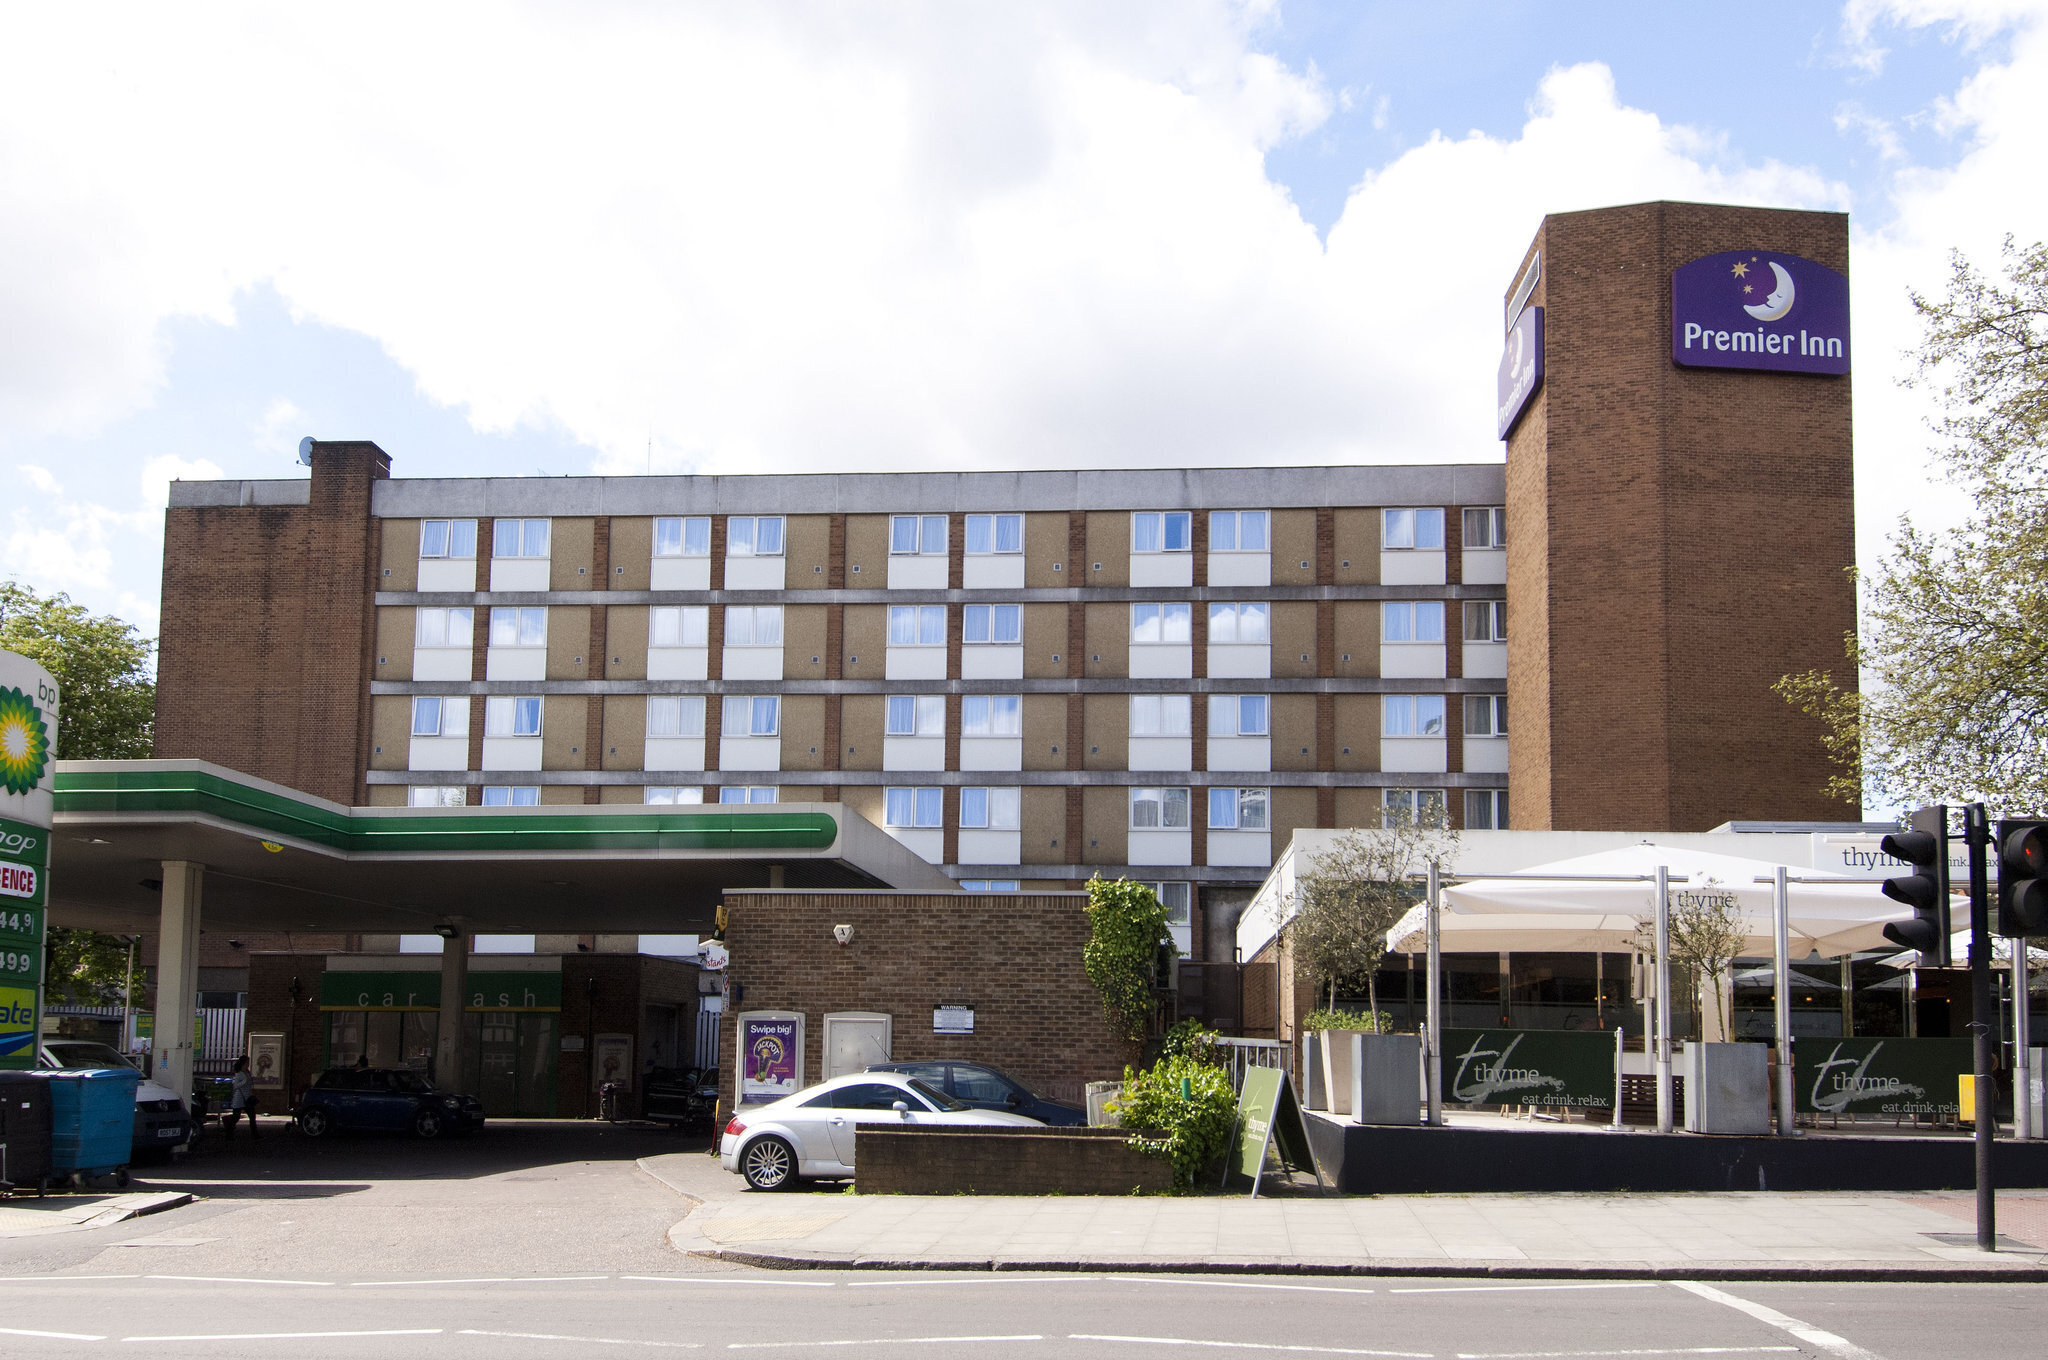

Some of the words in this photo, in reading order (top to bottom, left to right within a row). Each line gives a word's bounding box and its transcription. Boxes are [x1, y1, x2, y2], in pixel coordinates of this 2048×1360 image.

[1684, 322, 1795, 354] Premier
[1800, 329, 1842, 358] Inn
[1498, 376, 1523, 429] Premier
[1523, 358, 1534, 388] Inn
[38, 678, 56, 708] bp
[0, 866, 34, 893] ENCE
[1677, 890, 1734, 910] thyme
[706, 955, 726, 968] stants
[358, 992, 417, 1007] car
[473, 987, 536, 1007] ash
[750, 1024, 776, 1035] Swipe
[777, 1024, 792, 1035] big!
[757, 1040, 780, 1055] JACKPOT
[1474, 1063, 1539, 1086] thyme
[1832, 1072, 1899, 1094] thyme
[1248, 1115, 1267, 1134] thyme
